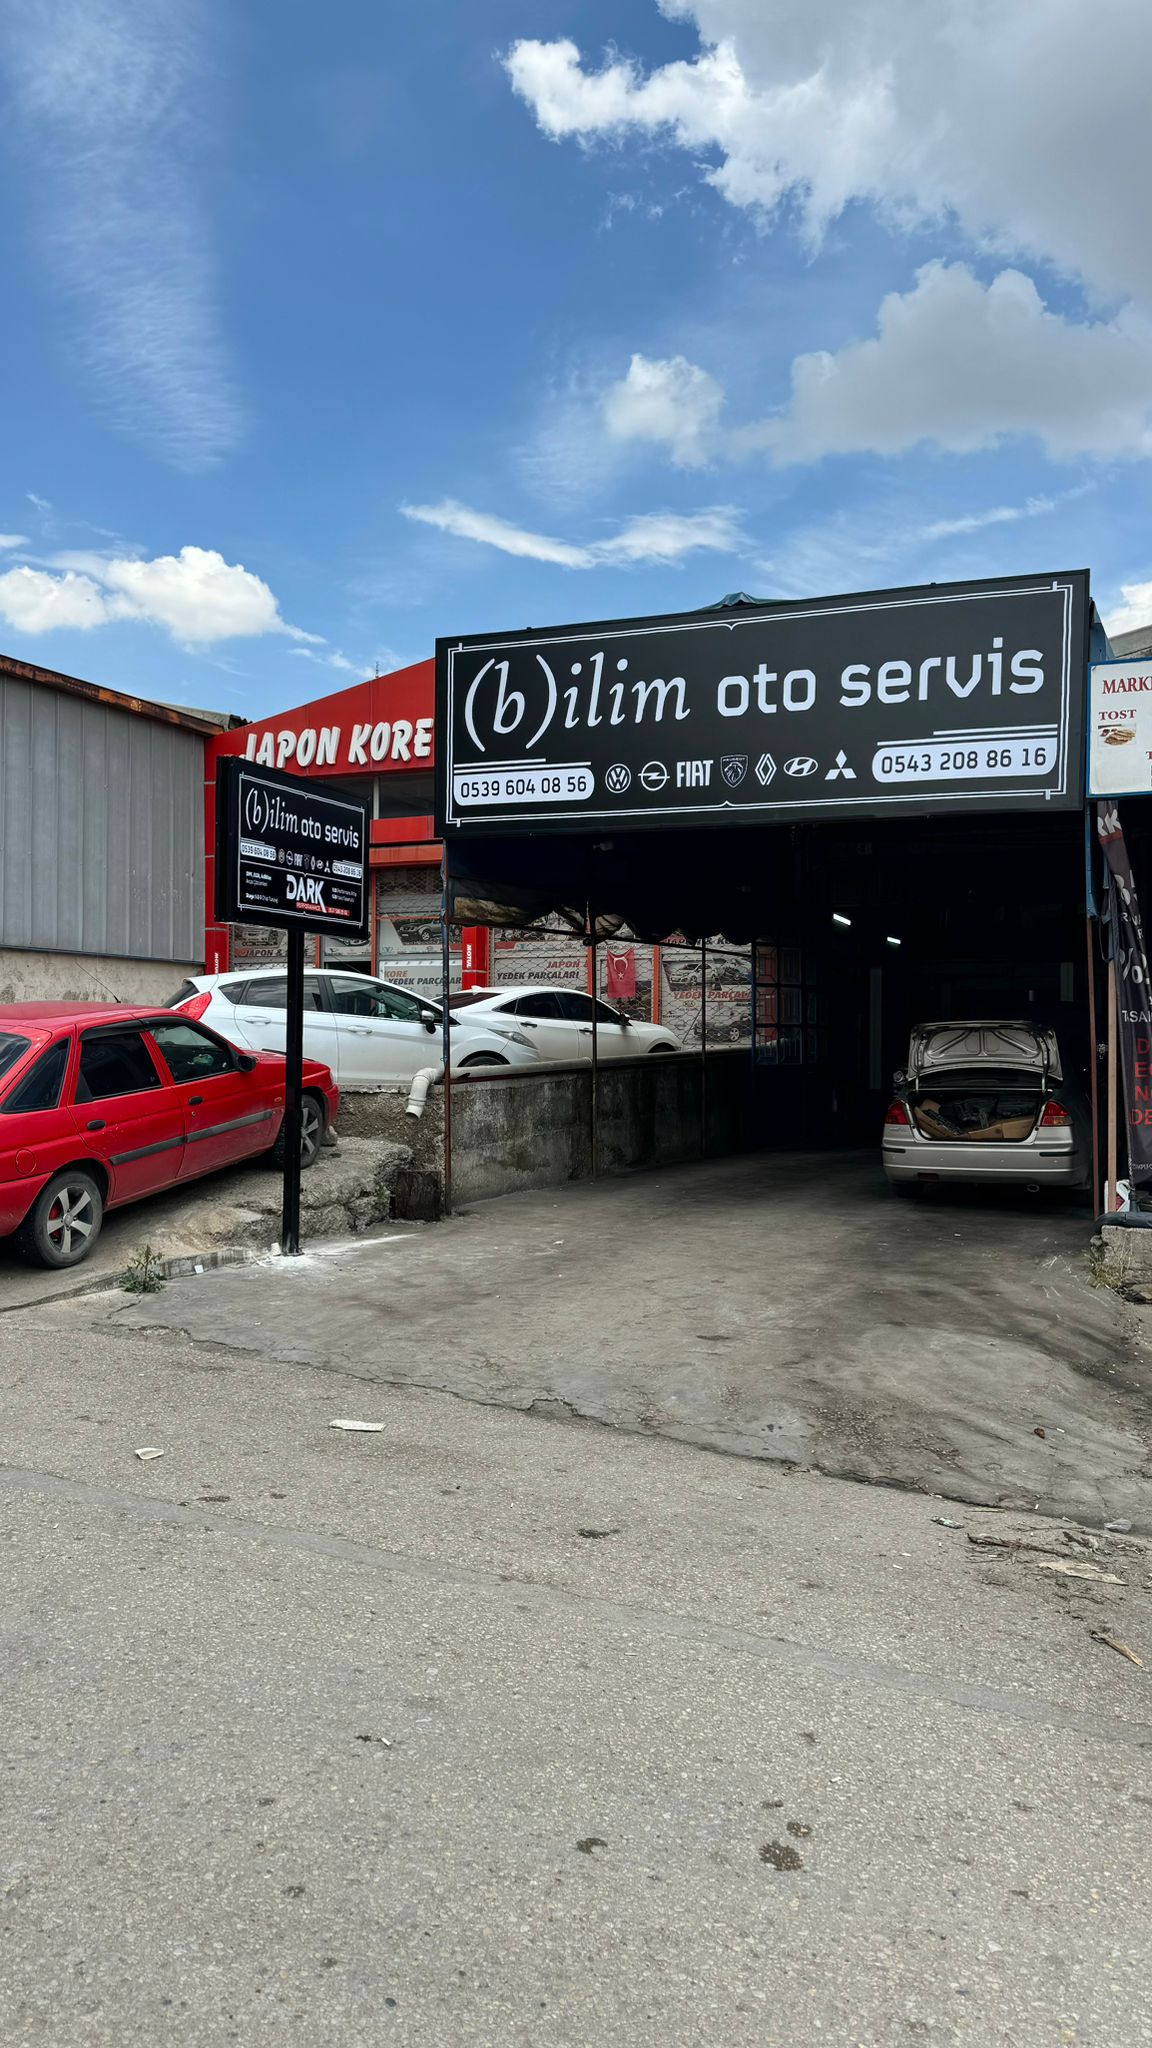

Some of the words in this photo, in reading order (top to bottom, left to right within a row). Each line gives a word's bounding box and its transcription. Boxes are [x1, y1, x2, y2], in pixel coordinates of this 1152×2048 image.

[464, 651, 691, 752] (b)ilim
[717, 663, 817, 717] oto
[839, 636, 1045, 707] servis
[1102, 676, 1152, 694] MARK
[1098, 709, 1137, 721] TOST
[239, 726, 341, 768] JAPON
[348, 718, 434, 766] KORE
[881, 753, 932, 774] 0543
[940, 751, 978, 771] 208
[986, 750, 1012, 768] 86
[1021, 747, 1047, 767] 16
[676, 760, 714, 788] FIAT
[460, 777, 500, 798] 0539
[505, 778, 536, 796] 604
[541, 777, 561, 794] 08
[567, 775, 587, 792] 56
[245, 788, 299, 834] (b)ilim
[301, 816, 322, 840] oto
[324, 825, 360, 849] servis
[286, 874, 327, 913] DARK
[384, 970, 408, 978] KORE
[497, 972, 526, 981] YEDEK
[528, 970, 580, 981] PARÇALARI
[546, 960, 581, 969] JAPON
[388, 977, 416, 985] YEDEK
